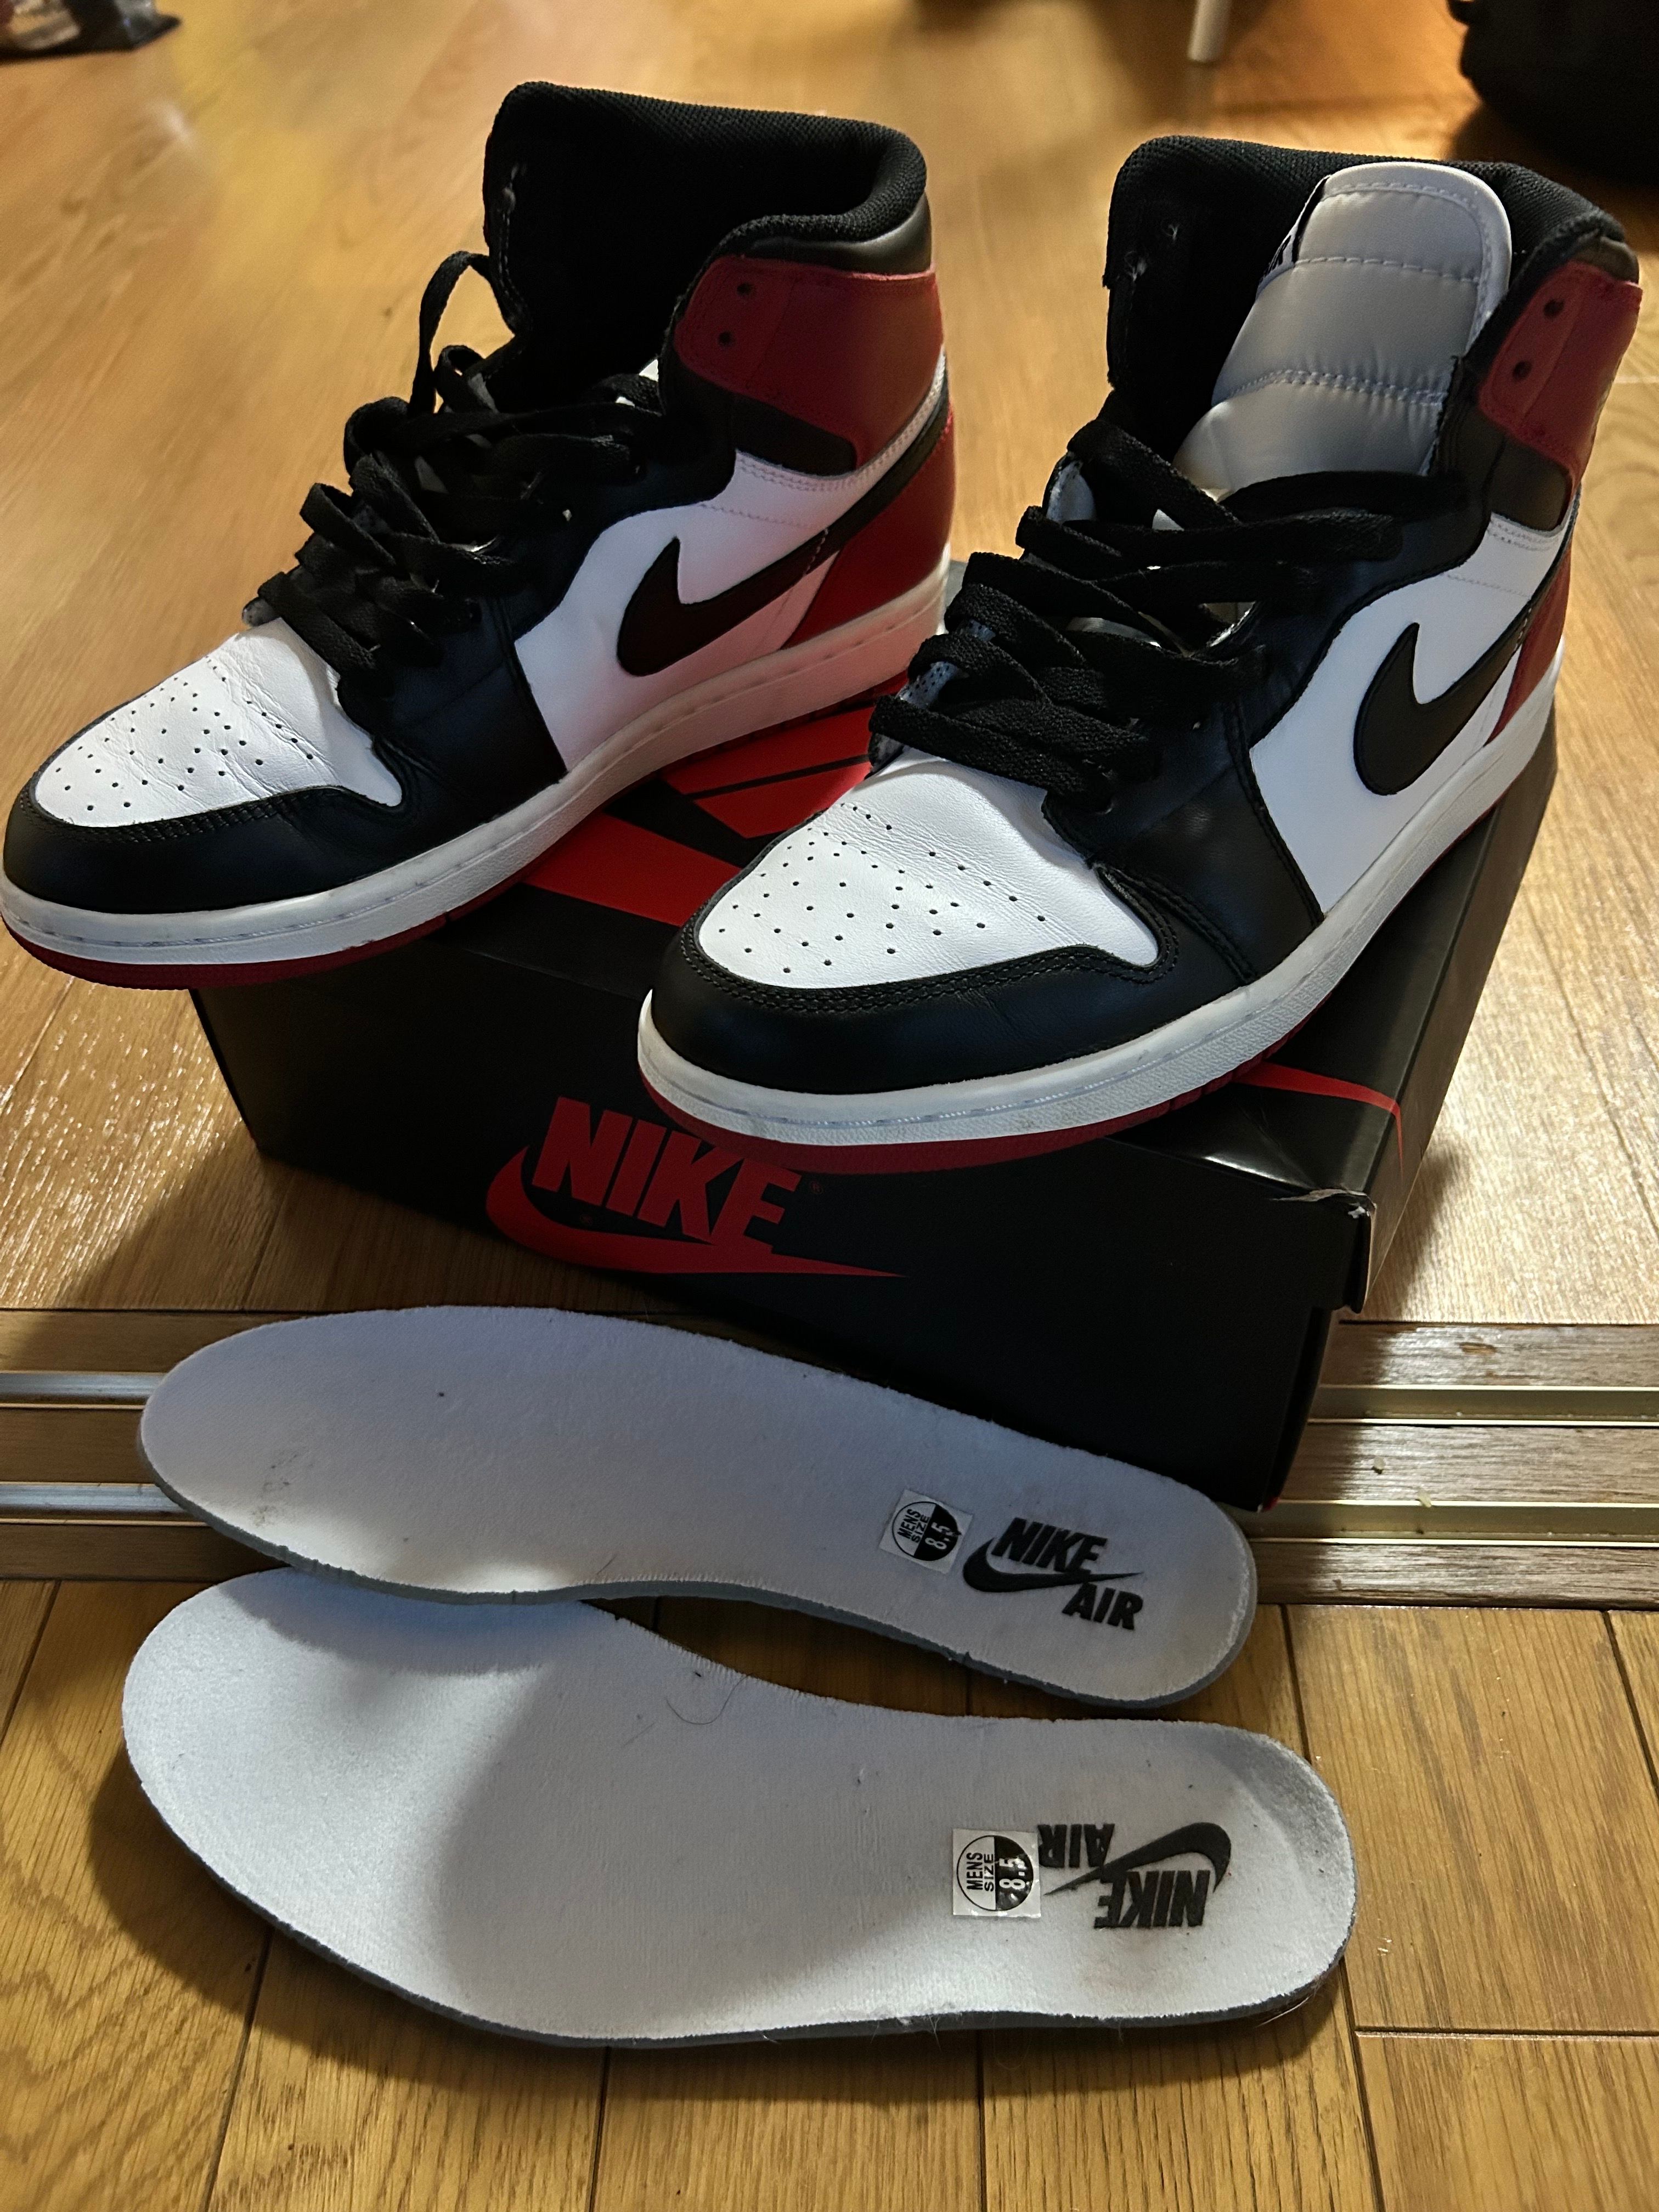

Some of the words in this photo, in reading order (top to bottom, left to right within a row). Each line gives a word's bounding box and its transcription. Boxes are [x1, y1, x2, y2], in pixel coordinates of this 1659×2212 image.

[532, 1097, 802, 1254] NIKE
[898, 1509, 921, 1539] MENS
[911, 1514, 929, 1543] SIZE
[925, 1522, 953, 1550] 8.5
[990, 1517, 1107, 1573] NIKE
[1062, 1583, 1143, 1630] AIR
[1037, 1824, 1115, 1867] AIR
[967, 1853, 983, 1890] MENS
[984, 1854, 994, 1891] SIZE
[999, 1858, 1026, 1889] 8.5
[1093, 1868, 1210, 1928] NIKE
